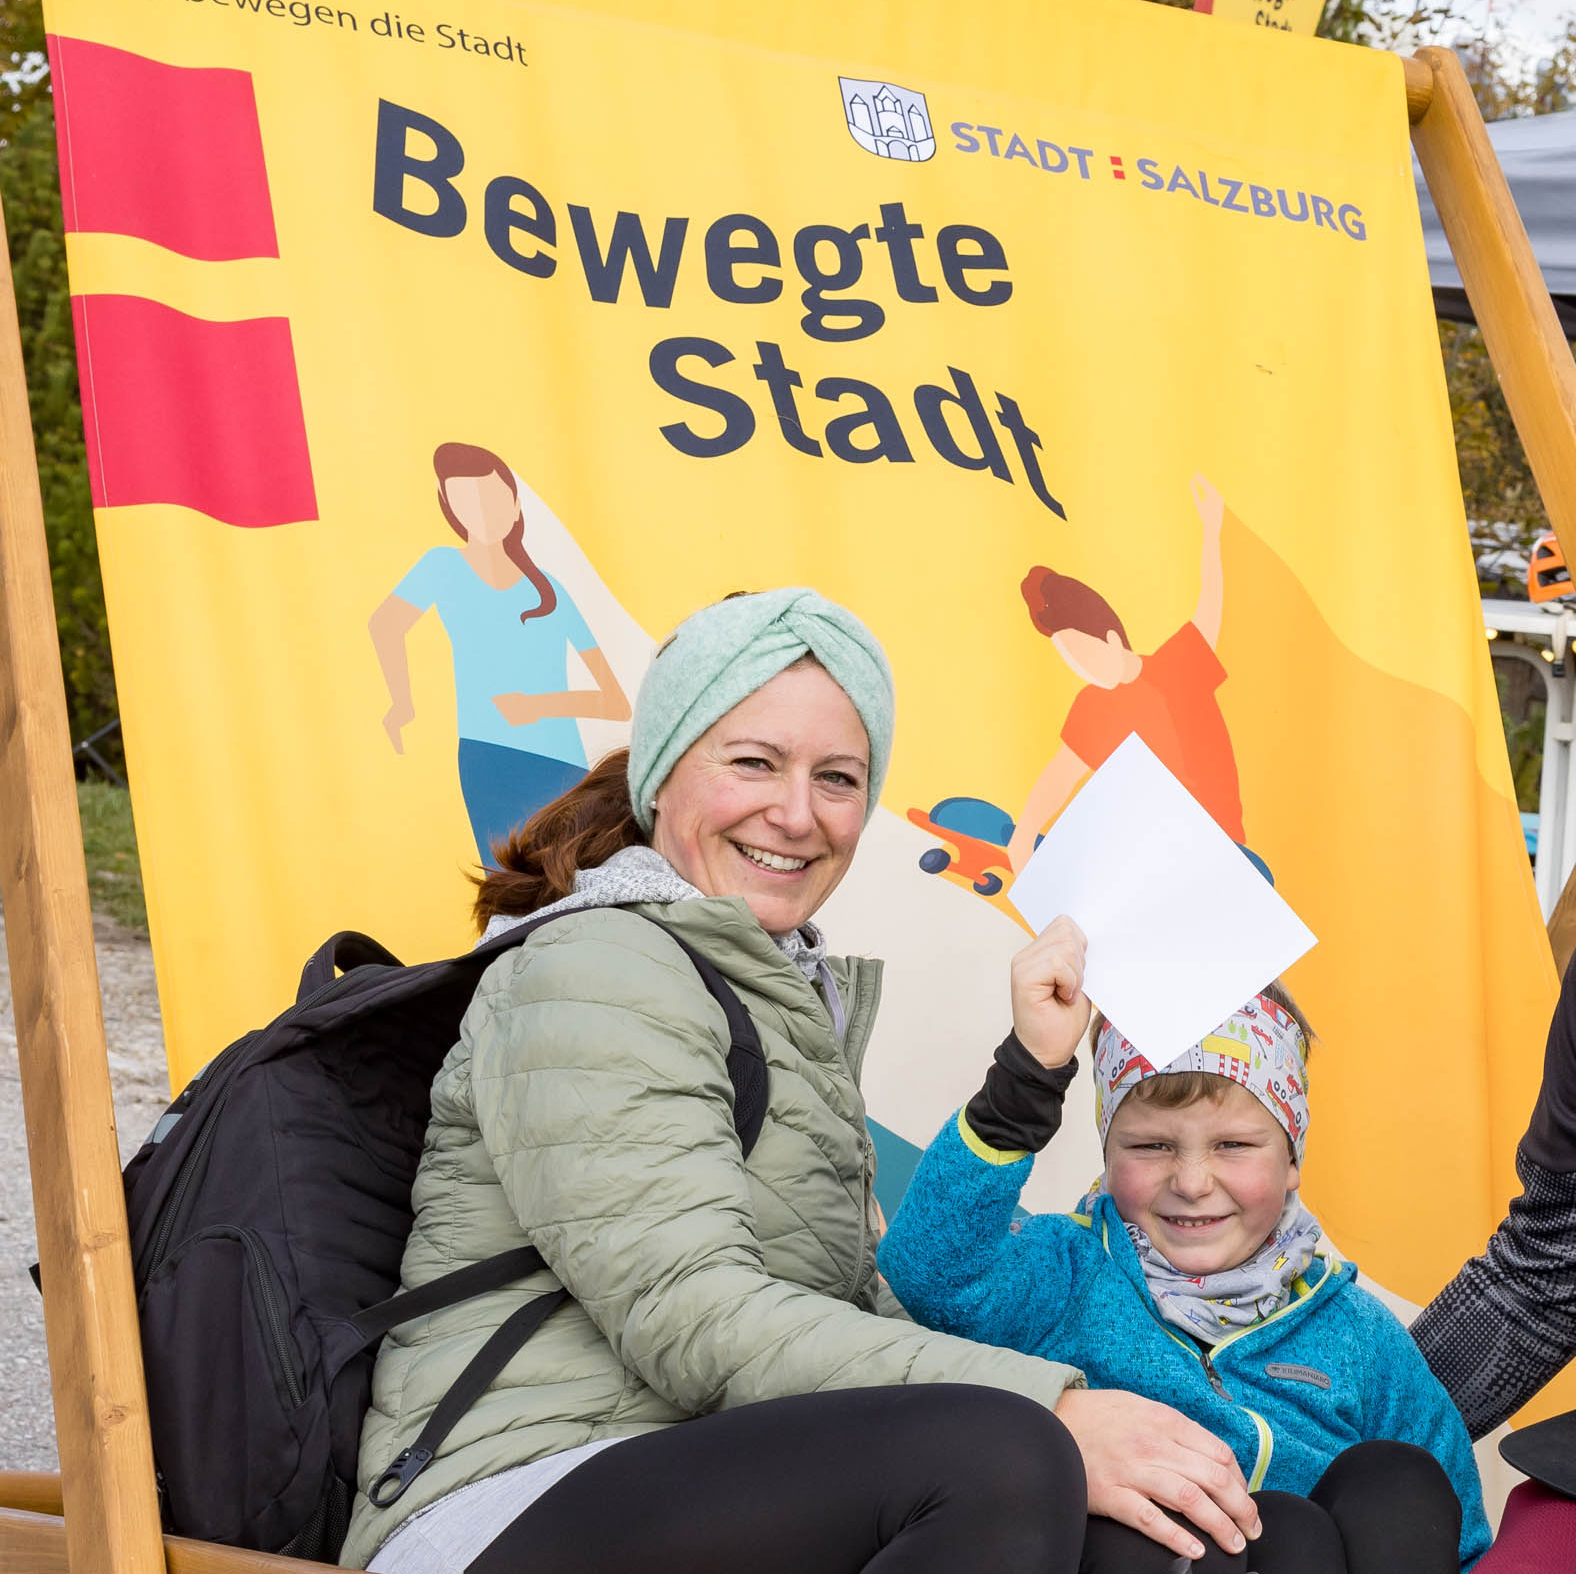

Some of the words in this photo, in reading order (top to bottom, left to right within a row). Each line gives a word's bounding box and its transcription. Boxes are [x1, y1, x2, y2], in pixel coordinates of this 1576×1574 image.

[370, 12, 426, 44] die
[436, 23, 530, 68] Stadt
[373, 98, 1013, 343] Bewegte
[951, 122, 1094, 180] STADT
[1137, 158, 1367, 241] SALZBURG
[649, 336, 1067, 521] Stadt
